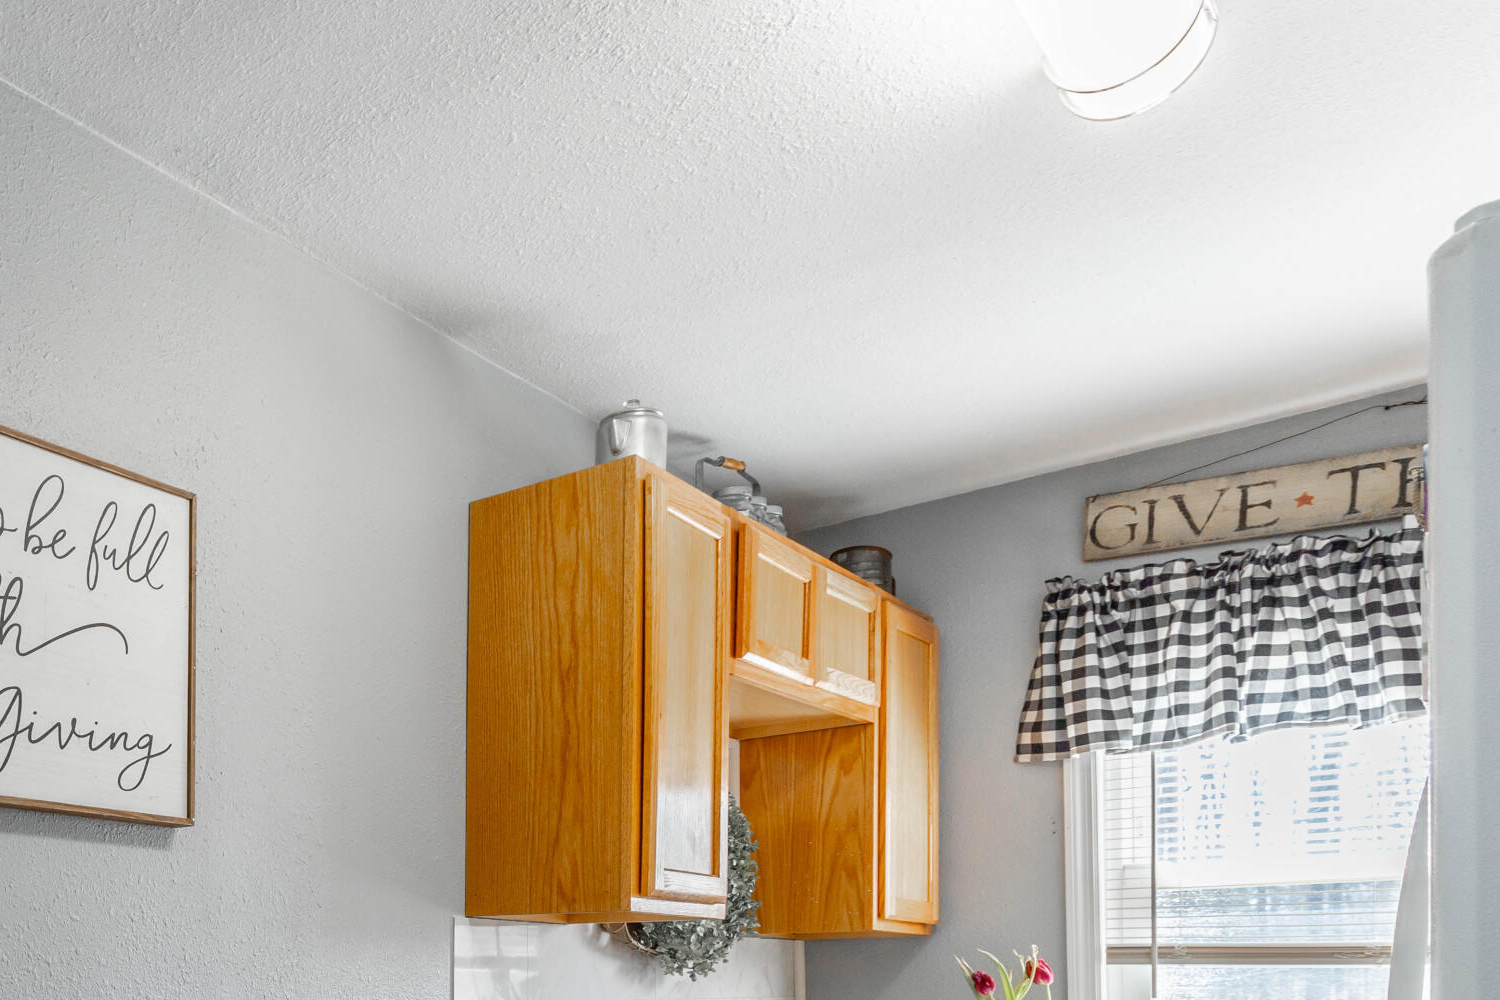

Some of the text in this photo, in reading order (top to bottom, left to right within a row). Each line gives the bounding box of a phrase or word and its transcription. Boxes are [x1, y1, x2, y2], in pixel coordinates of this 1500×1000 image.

[23, 474, 76, 560] be
[86, 501, 170, 591] full
[1087, 479, 1280, 552] GIVE
